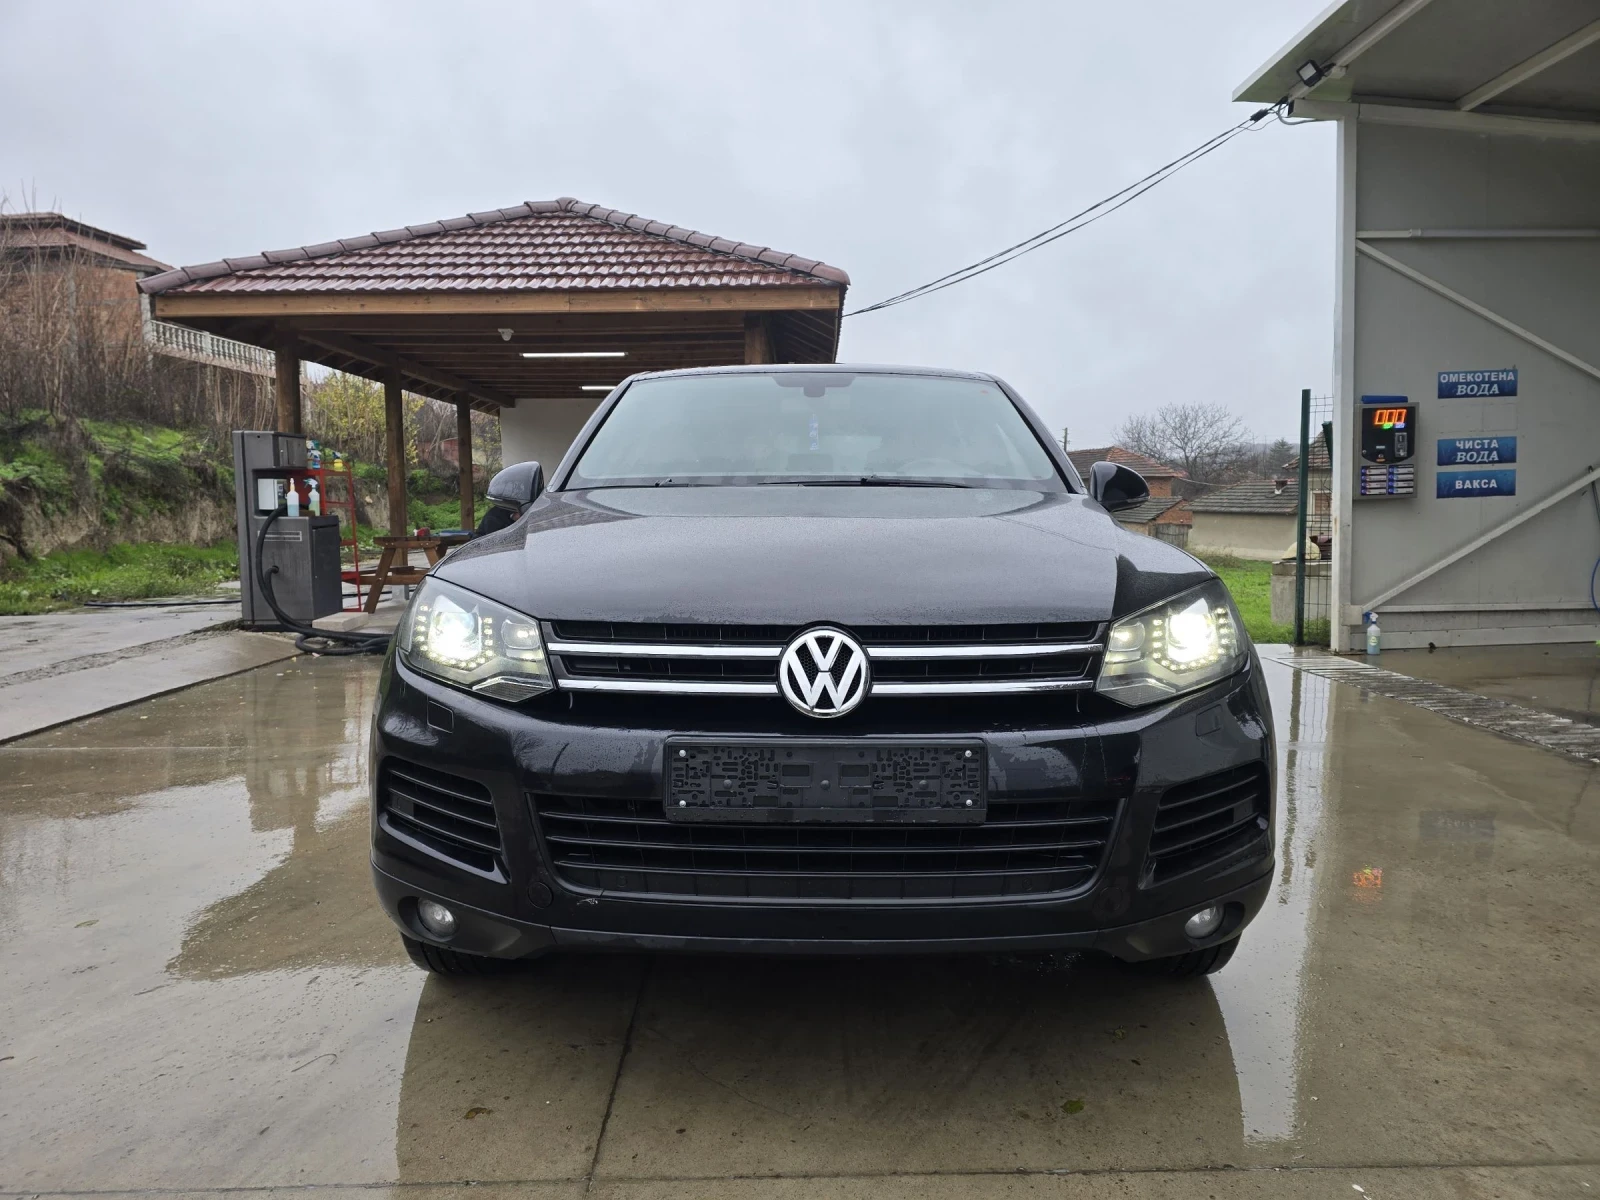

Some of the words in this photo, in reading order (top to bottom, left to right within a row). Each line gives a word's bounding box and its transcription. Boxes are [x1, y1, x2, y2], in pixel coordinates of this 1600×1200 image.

[1440, 371, 1515, 383] ОМЕКОТЕНА
[1456, 384, 1500, 396] ВОДА
[1455, 439, 1499, 449] ЧИСТА
[1455, 451, 1499, 463] ВОДА
[1455, 479, 1498, 490] ВАКСА
[784, 631, 866, 714] VW
